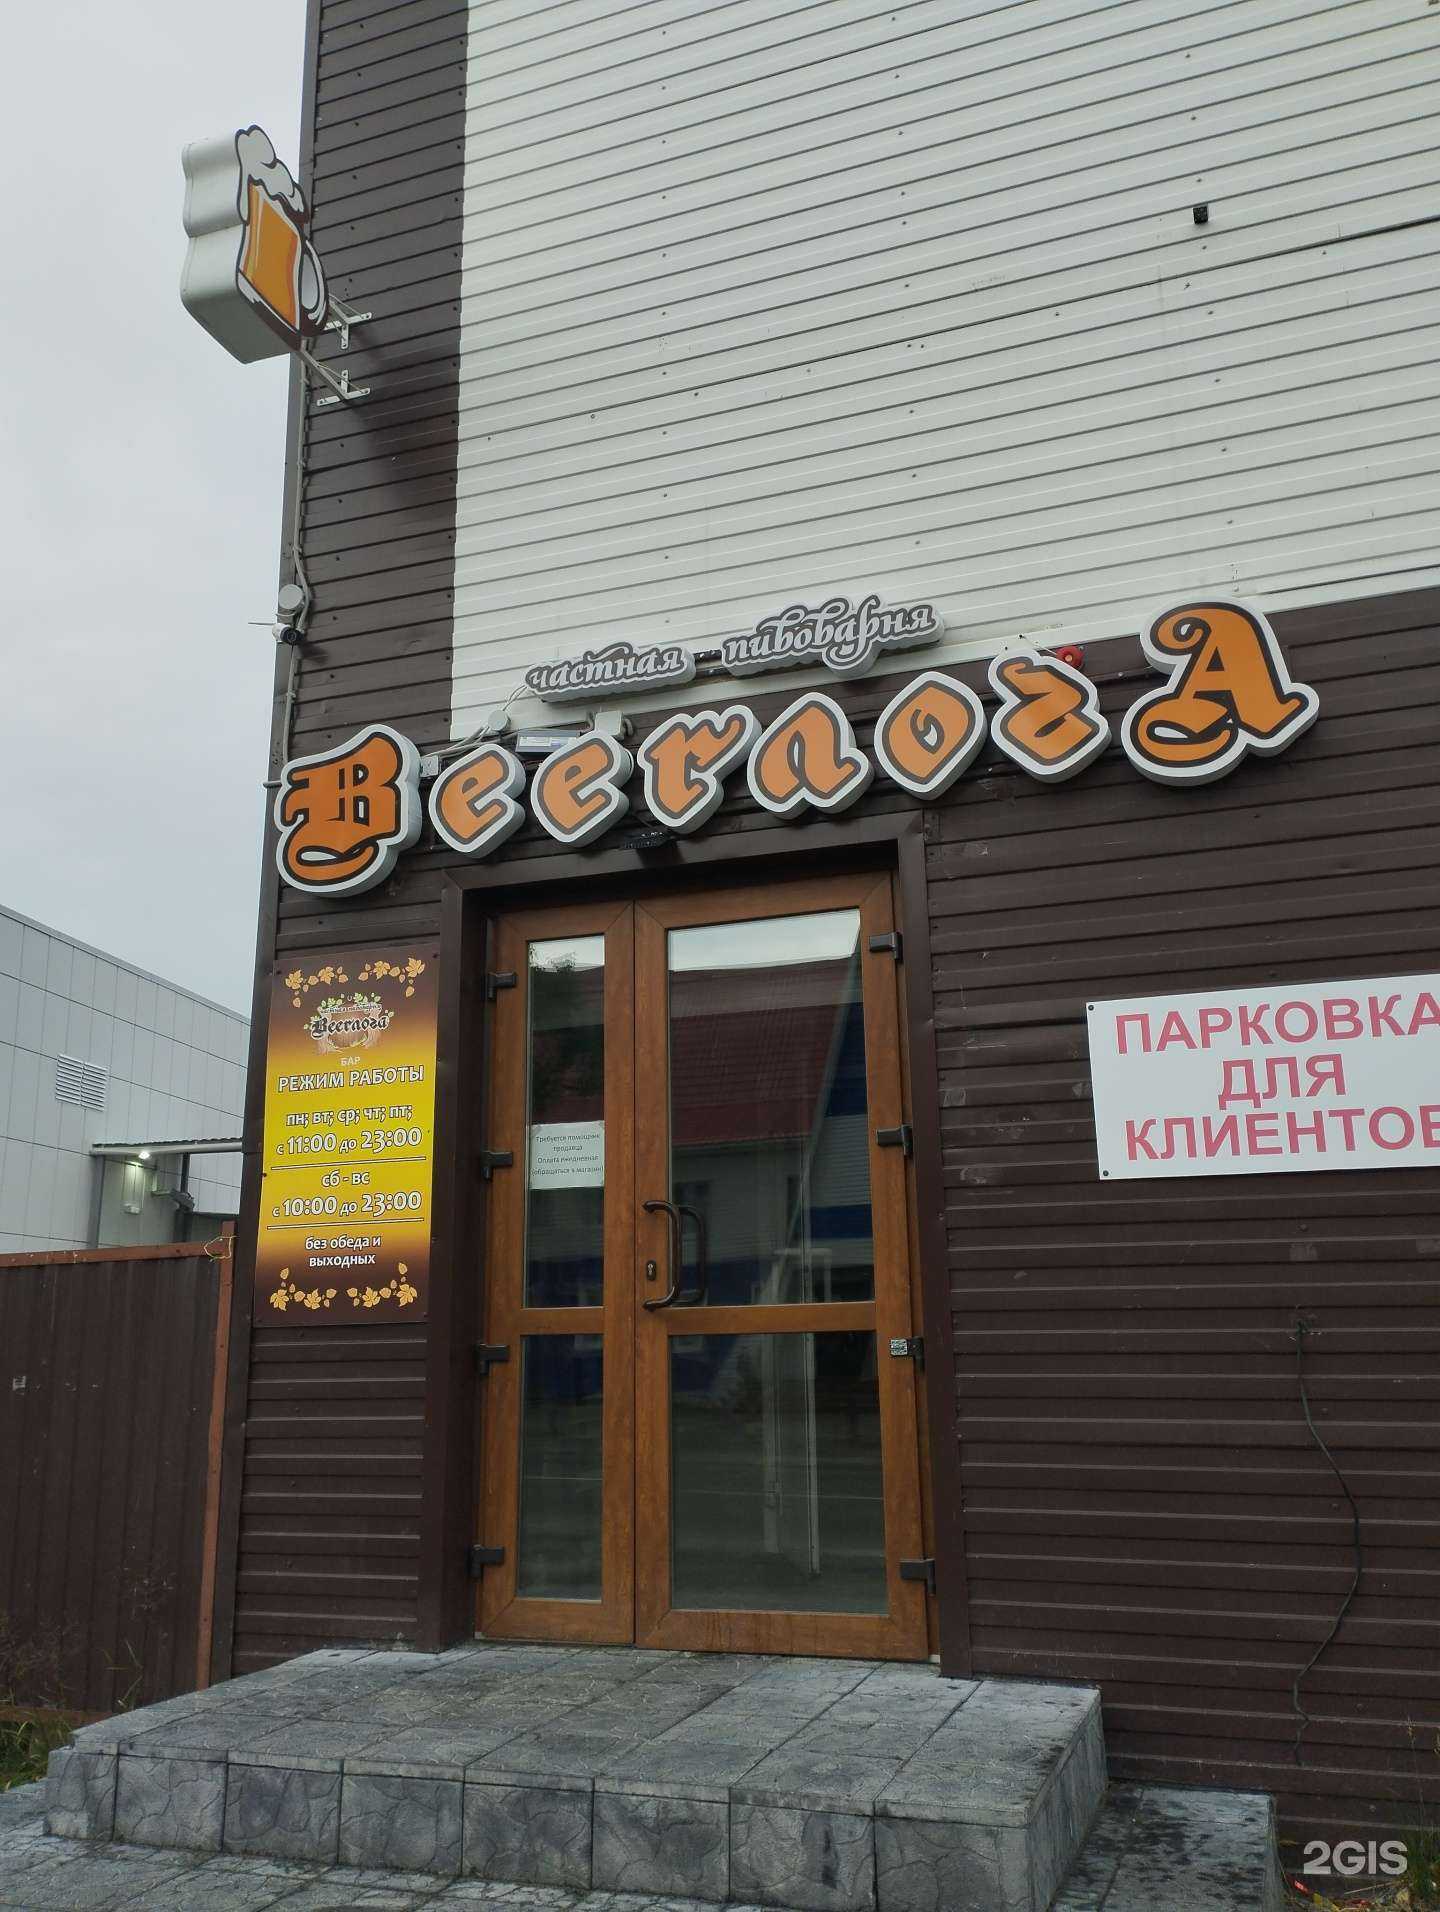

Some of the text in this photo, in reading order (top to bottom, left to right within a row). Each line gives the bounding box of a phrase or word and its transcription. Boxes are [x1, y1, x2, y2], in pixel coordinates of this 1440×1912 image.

[528, 596, 941, 692] частная пивоварня
[1115, 992, 1440, 1054] ПАРКОВКА
[340, 1056, 361, 1066] БАР
[278, 1065, 424, 1092] РЕЖИМ РАБОТЫ
[1218, 1053, 1346, 1110] ДЛЯ
[286, 1113, 310, 1128] пн;
[312, 1111, 334, 1126] вт;
[389, 1105, 413, 1120] пт;
[287, 1133, 338, 1154] 11:00
[339, 1138, 357, 1153] до
[360, 1127, 422, 1154] 23:00
[322, 1169, 340, 1187] сб
[352, 1171, 370, 1185] вс
[282, 1195, 338, 1216] 10:00
[339, 1202, 358, 1216] до
[361, 1190, 422, 1217] 23:00
[305, 1235, 381, 1250] без обеда и
[309, 1254, 376, 1268] выходных
